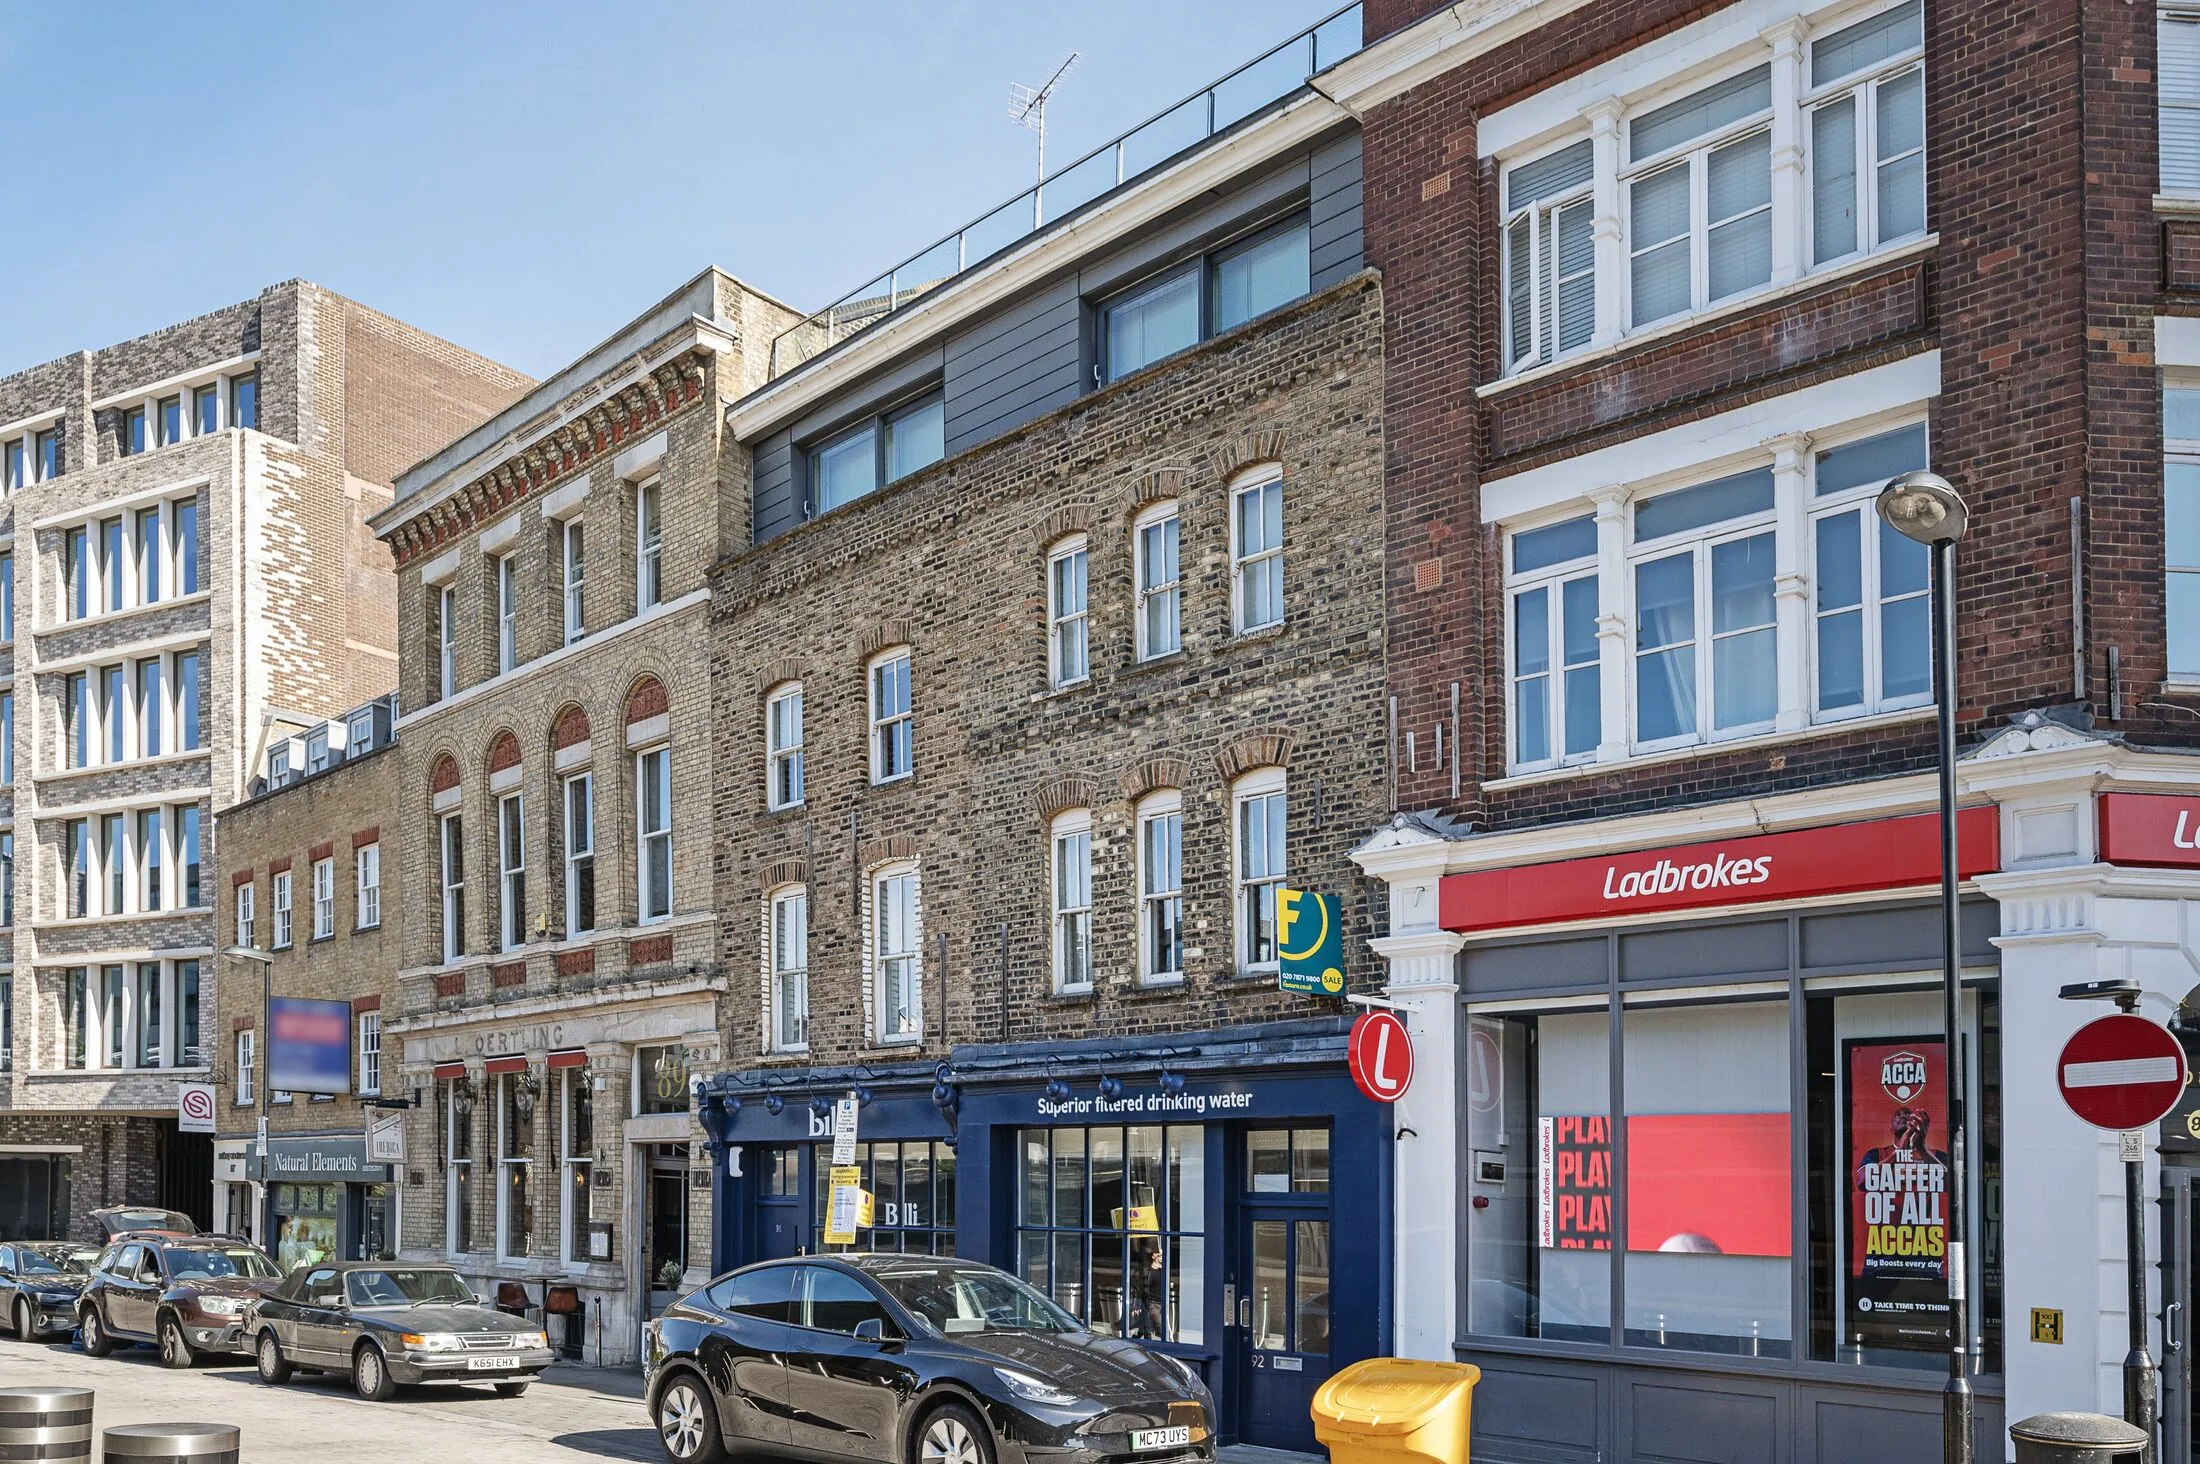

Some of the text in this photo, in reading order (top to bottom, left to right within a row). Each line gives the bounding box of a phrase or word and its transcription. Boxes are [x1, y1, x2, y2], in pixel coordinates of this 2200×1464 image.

[1603, 853, 1772, 900] Ladbrokes
[1276, 889, 1303, 945] F
[1282, 972, 1293, 980] 020
[1293, 973, 1306, 982] 7871
[1323, 976, 1342, 985] SALE
[475, 1024, 563, 1053] OERTLING
[1374, 1023, 1397, 1089] L
[657, 1058, 687, 1098] 89
[1881, 1062, 1927, 1085] ACCA
[1037, 1092, 1253, 1117] Superior filtered drinking water
[808, 1105, 837, 1137] bil
[275, 1152, 357, 1172] Natural Elements
[1895, 1149, 1913, 1162] THE
[1865, 1163, 1944, 1192] GAFFER
[885, 1202, 918, 1226] Blli
[1865, 1192, 1944, 1225] OF ALL
[1866, 1225, 1944, 1256] ACCAS
[1866, 1259, 1878, 1267] Big
[1880, 1259, 1903, 1267] Boosts
[1905, 1261, 1926, 1269] every
[474, 1357, 514, 1368] K651 EHX
[1251, 1354, 1264, 1368] 92
[1139, 1428, 1187, 1446] MC73 UYS
